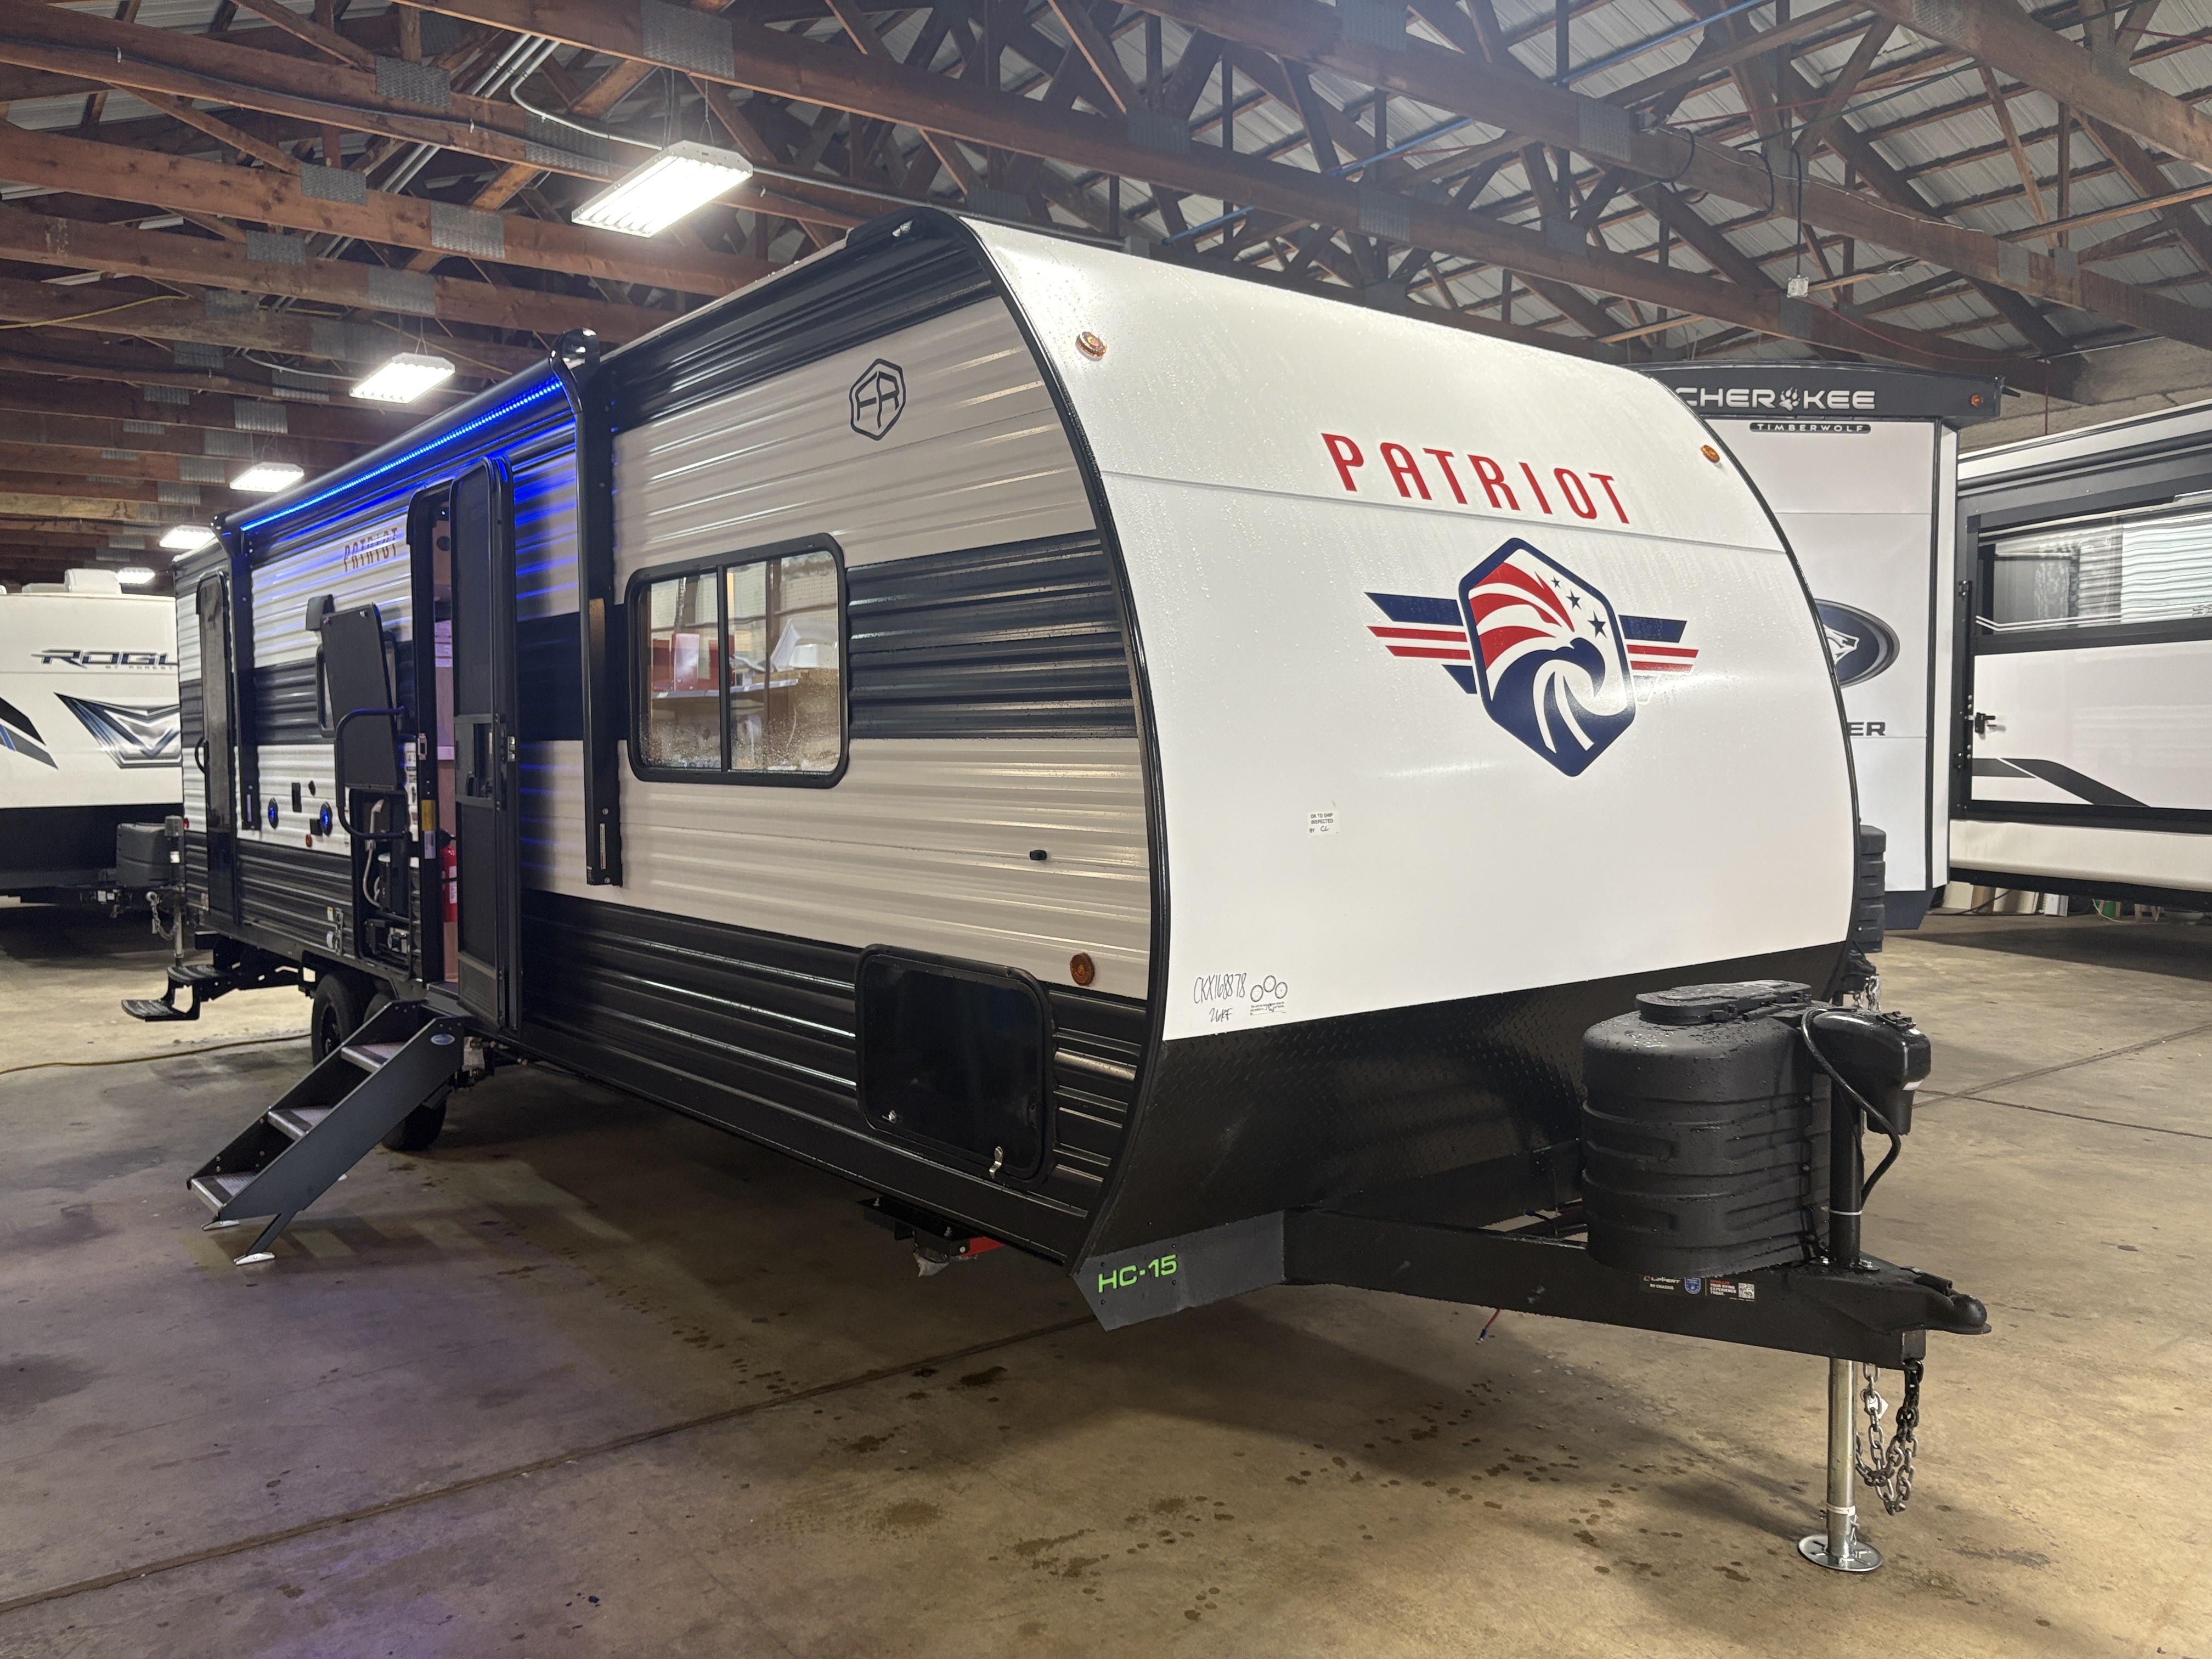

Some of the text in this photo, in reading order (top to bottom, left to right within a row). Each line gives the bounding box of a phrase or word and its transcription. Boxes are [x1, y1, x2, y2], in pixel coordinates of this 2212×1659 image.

[1757, 424, 1864, 432] TIMBERWOLF
[1321, 432, 1630, 524] PATRIOT
[343, 527, 398, 573] PATRIOT
[1098, 1254, 1177, 1293] HC-15
